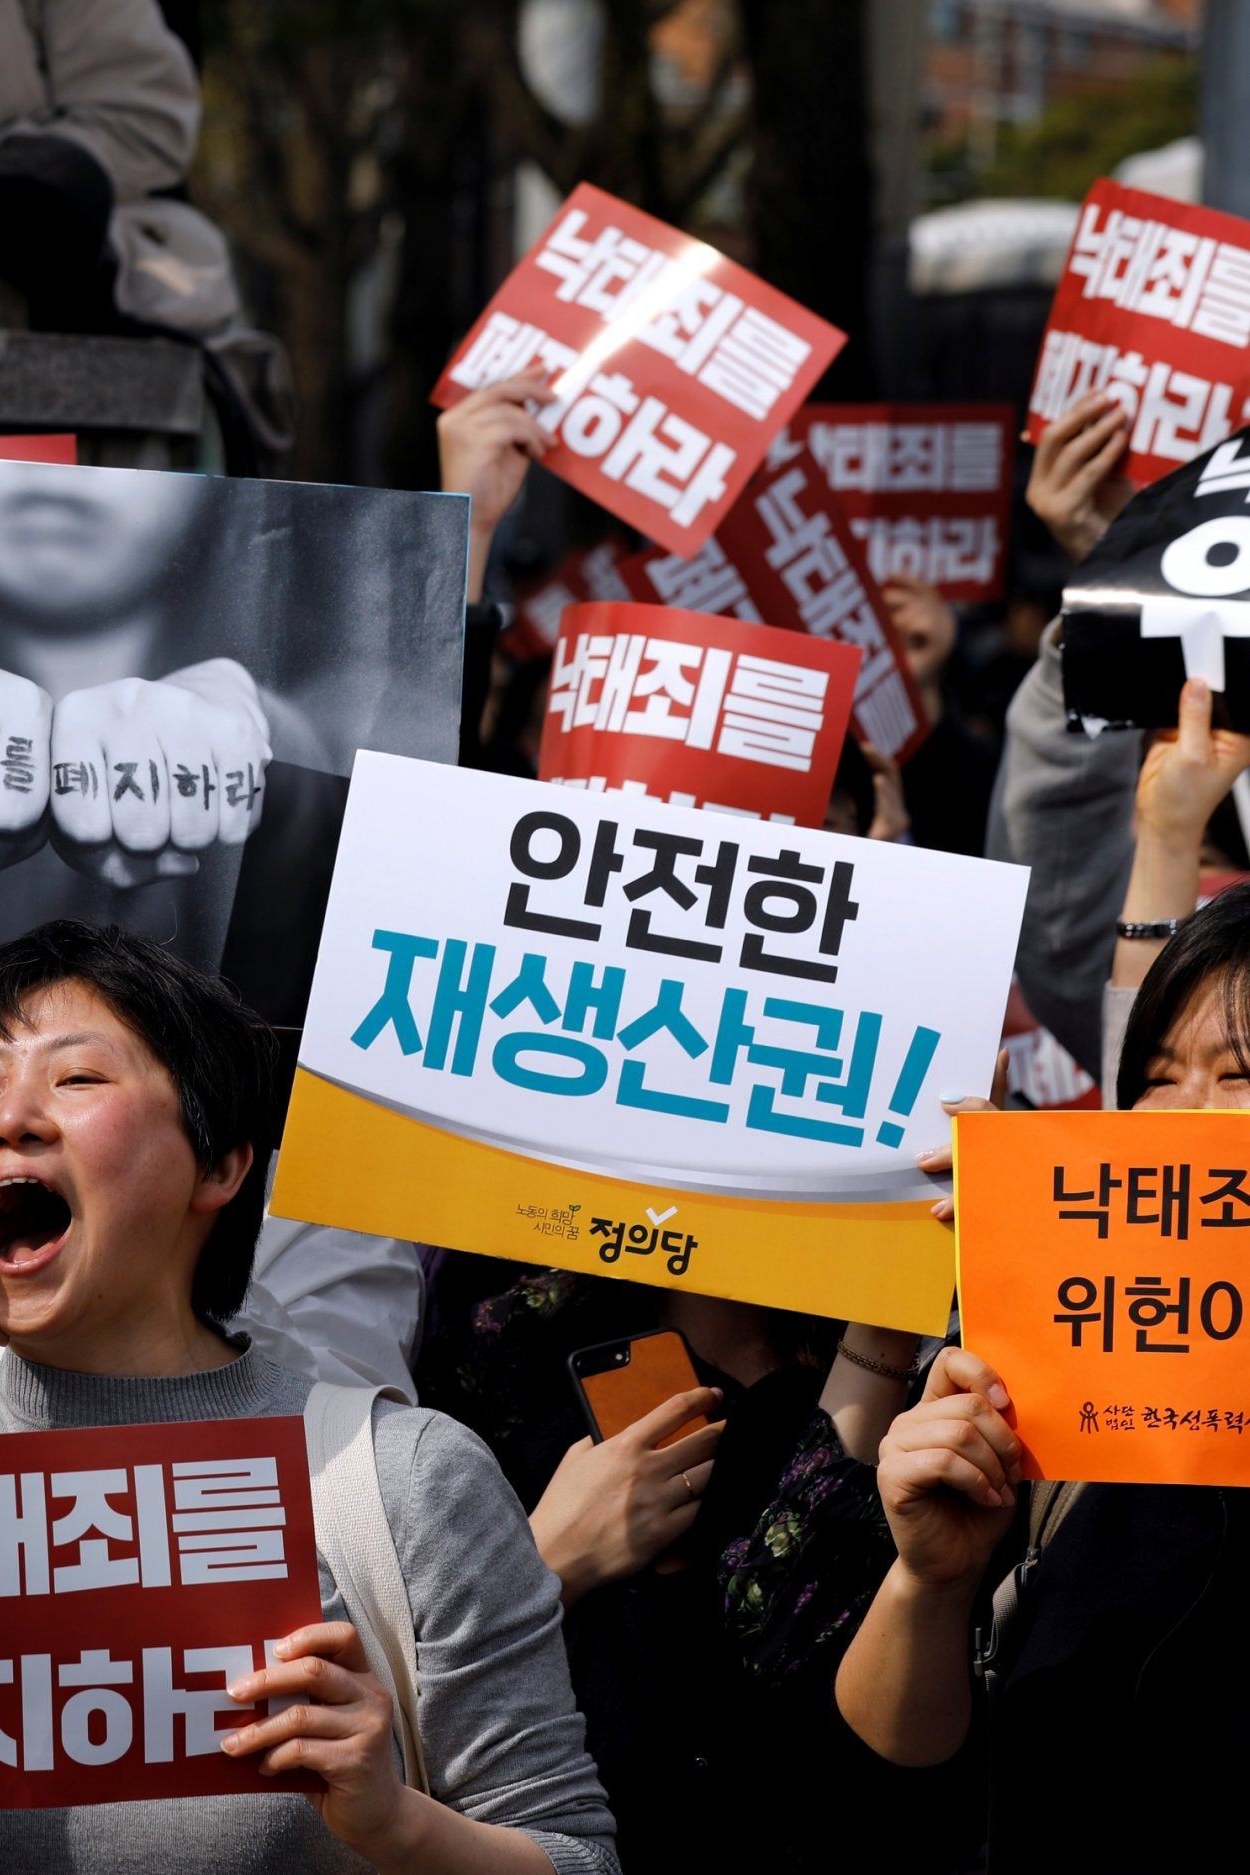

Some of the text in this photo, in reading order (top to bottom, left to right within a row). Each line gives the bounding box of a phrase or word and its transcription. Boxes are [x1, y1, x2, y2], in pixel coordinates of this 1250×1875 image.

[549, 633, 830, 773] 낙태죄를
[53, 760, 262, 812] 폐지하라
[503, 811, 859, 984] 안전한
[350, 929, 942, 1149] 재생산권!
[516, 1204, 575, 1226] 노동의 희망
[533, 1221, 580, 1241] 시민의 꿈
[589, 1217, 699, 1276] 정의당
[1103, 1404, 1135, 1417] 사단
[1106, 1418, 1135, 1431] 법인
[1140, 1406, 1250, 1435] 한국성폭력
